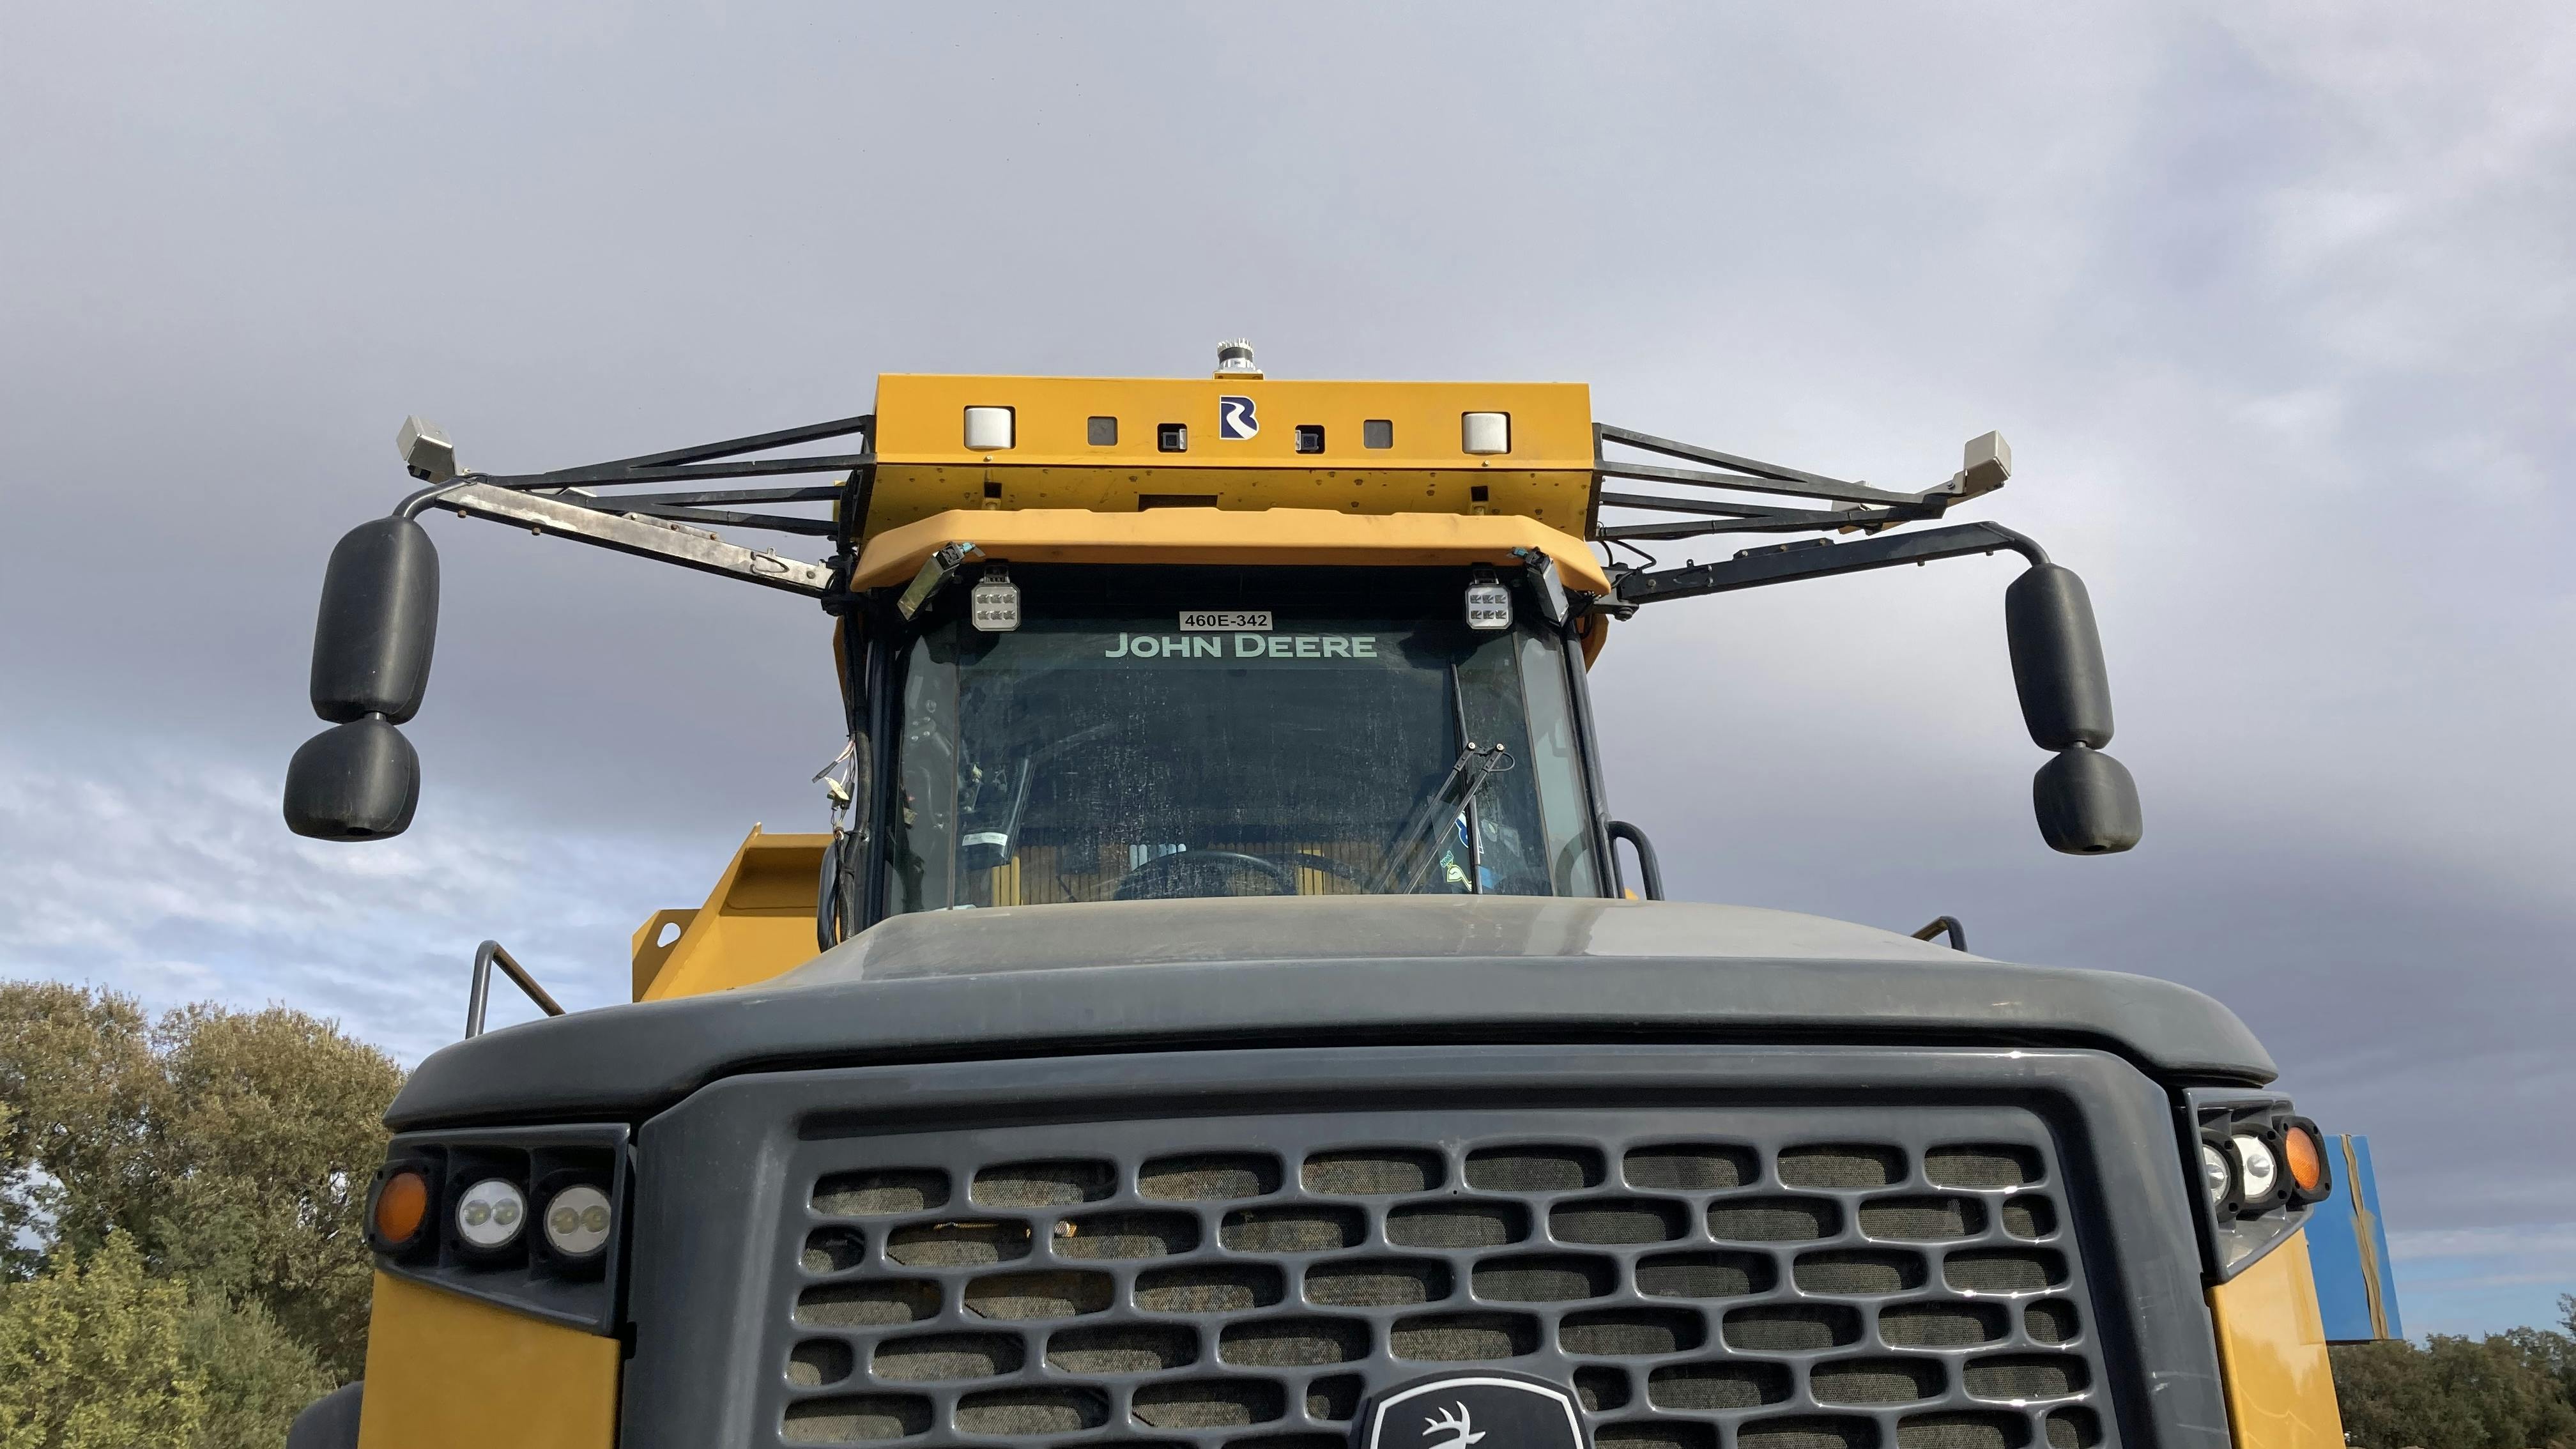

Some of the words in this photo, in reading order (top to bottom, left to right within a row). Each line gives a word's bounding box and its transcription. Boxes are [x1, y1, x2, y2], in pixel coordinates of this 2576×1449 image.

[1185, 615, 1268, 627] 460E-342
[1105, 632, 1222, 657] JOHN
[1235, 632, 1377, 657] DEERE
